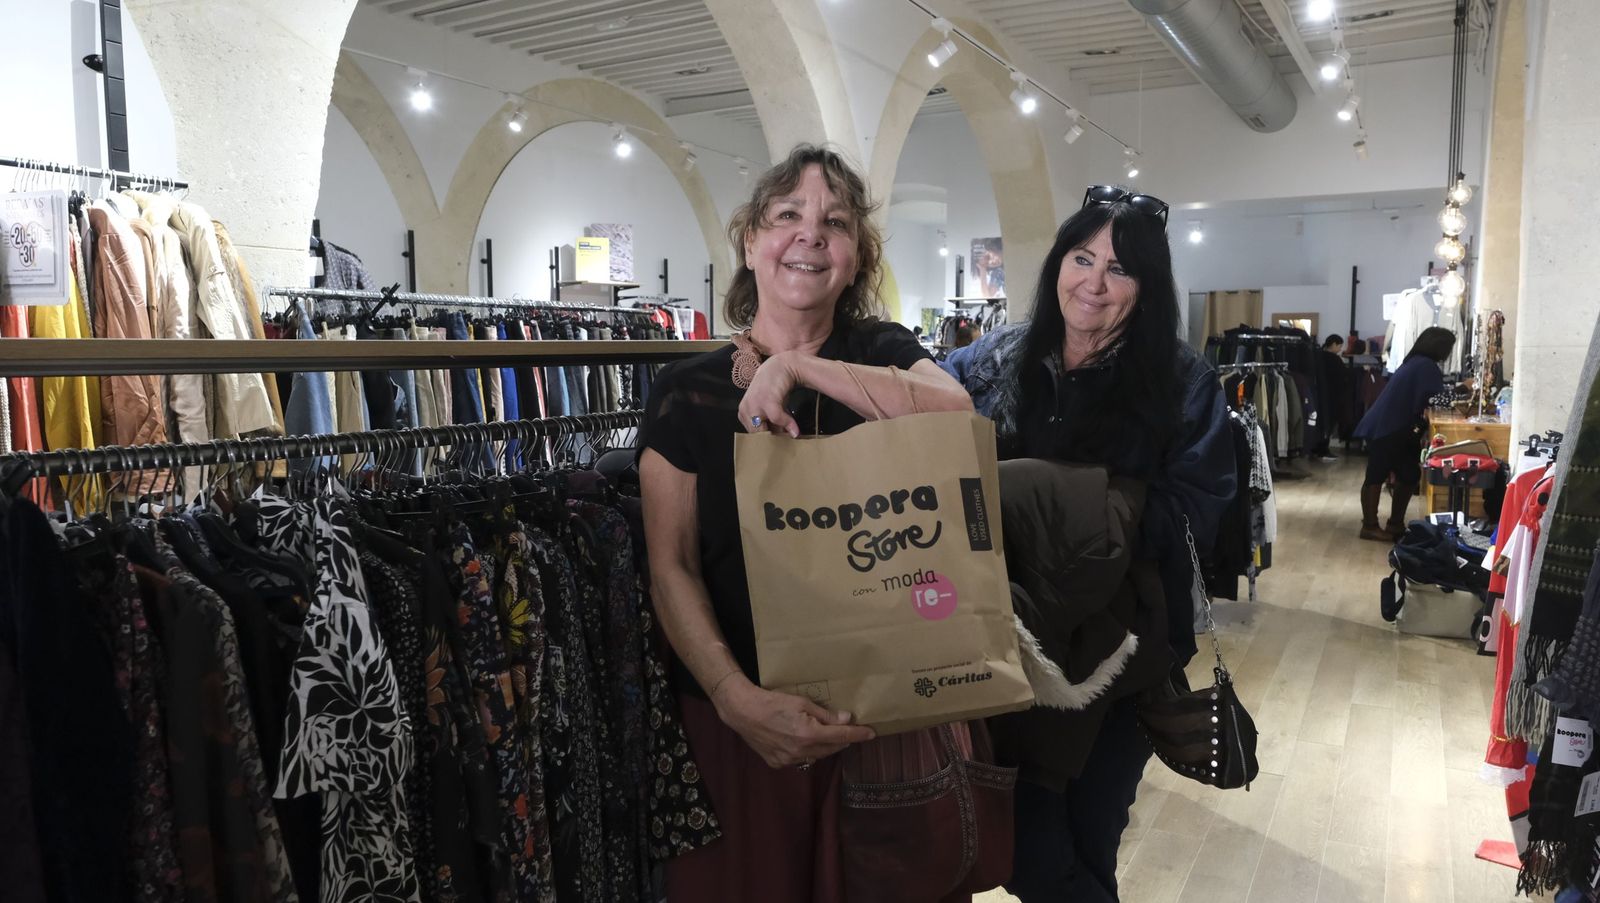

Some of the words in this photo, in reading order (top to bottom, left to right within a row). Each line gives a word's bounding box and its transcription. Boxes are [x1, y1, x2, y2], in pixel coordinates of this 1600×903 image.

[763, 485, 939, 531] koopera
[973, 488, 984, 521] CLOTHES
[847, 520, 942, 572] Store
[969, 522, 979, 541] LOVE
[978, 521, 987, 541] USED
[852, 586, 878, 598] con
[881, 568, 939, 592] moda
[938, 671, 993, 687] Cáritas
